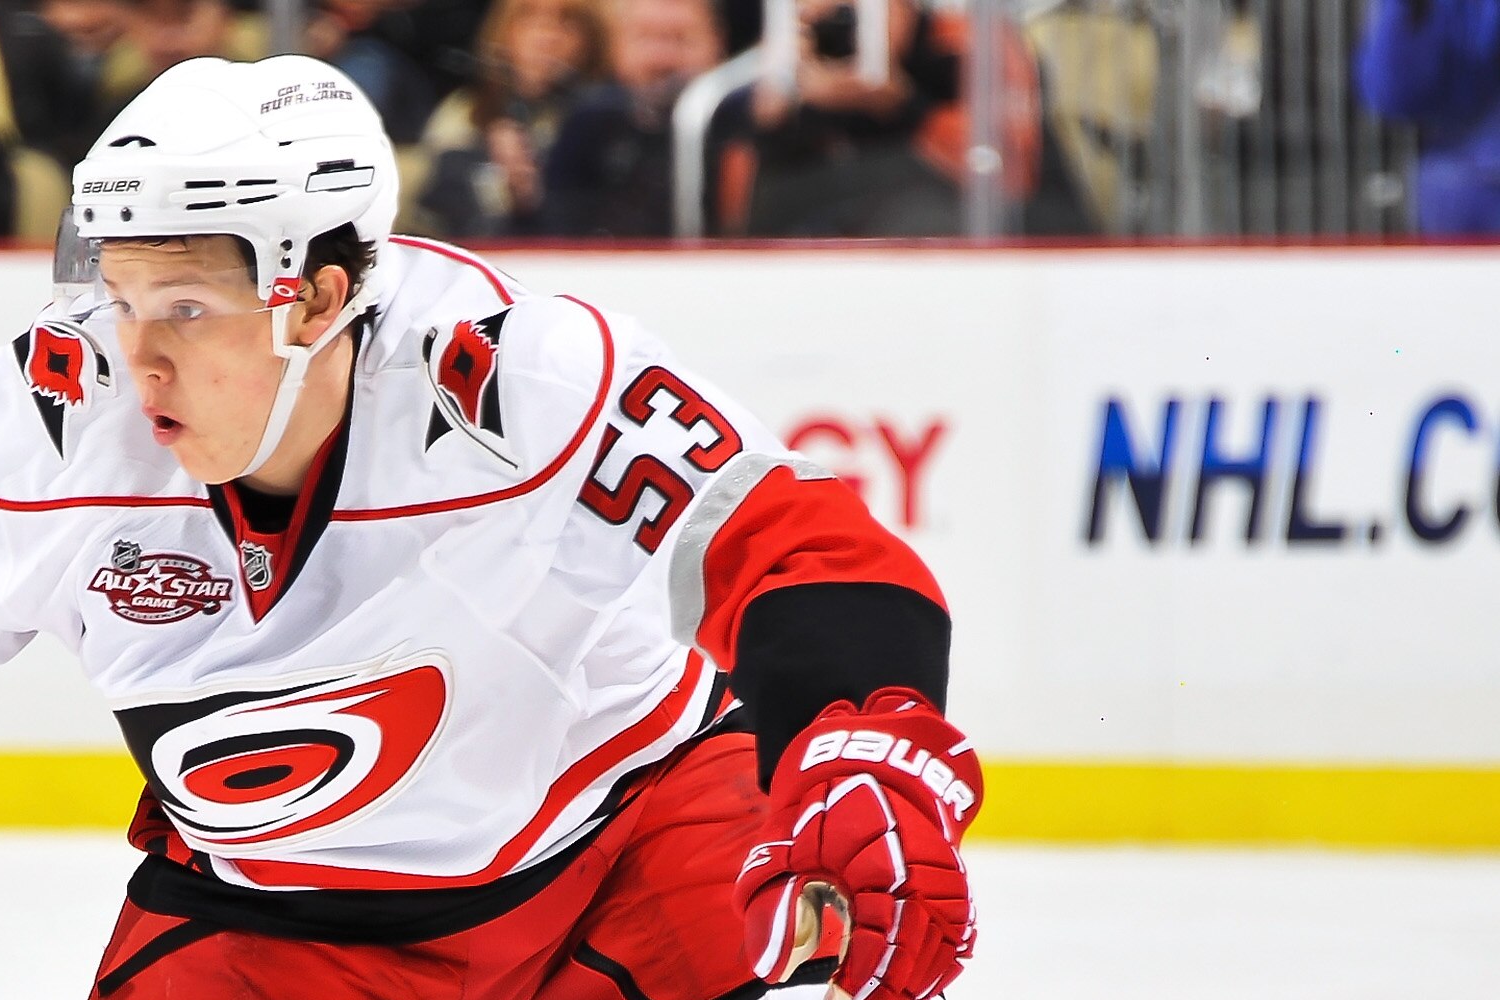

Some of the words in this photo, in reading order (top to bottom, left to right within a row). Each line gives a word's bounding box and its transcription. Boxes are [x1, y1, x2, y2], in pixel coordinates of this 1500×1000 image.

[576, 365, 744, 556] 53
[1084, 392, 1499, 547] NHL.C
[93, 569, 134, 591] ALL
[162, 578, 230, 597] STAR
[131, 596, 178, 609] GAME
